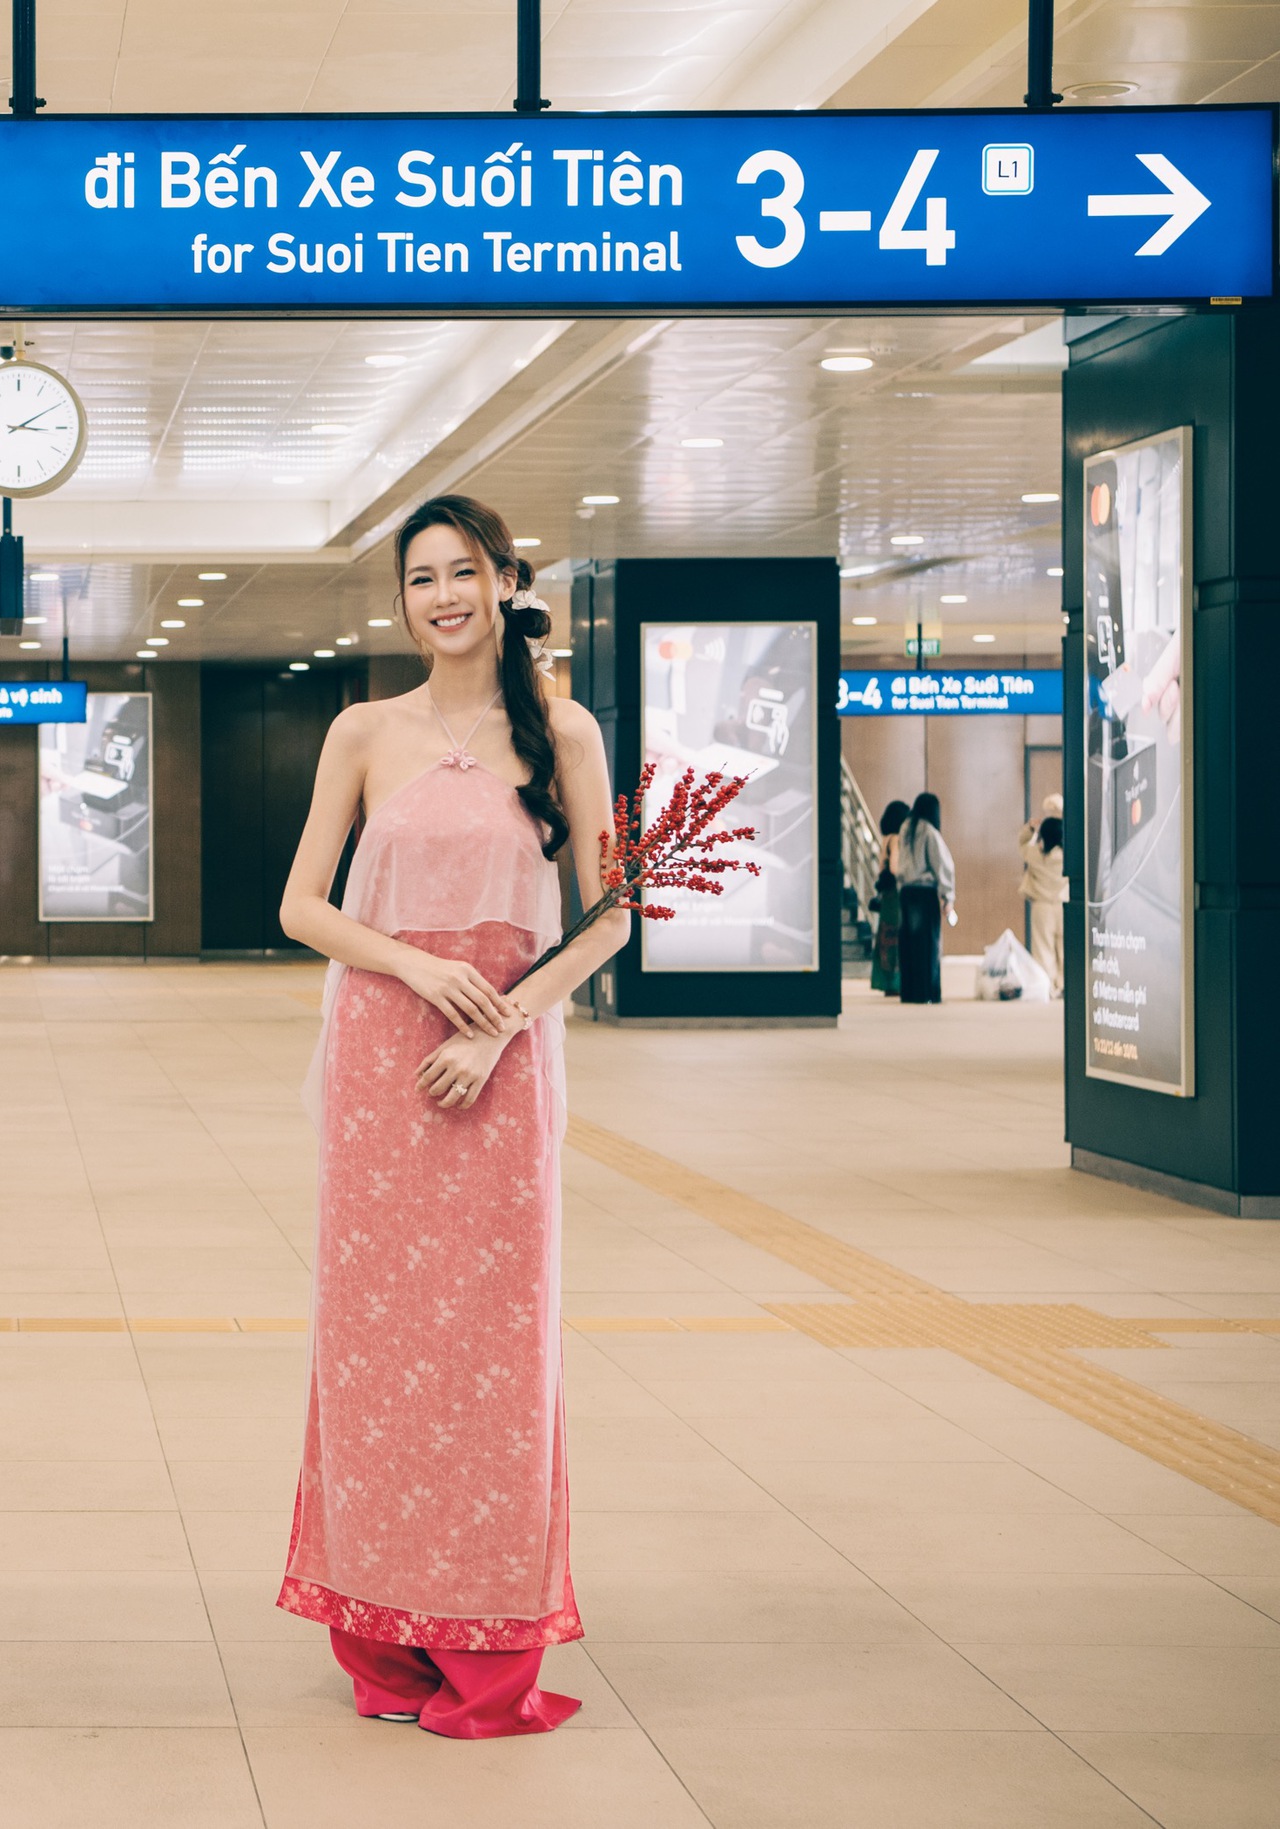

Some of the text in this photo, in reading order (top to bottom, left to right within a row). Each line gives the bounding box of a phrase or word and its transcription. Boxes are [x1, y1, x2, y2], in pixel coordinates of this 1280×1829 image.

[85, 143, 683, 209] đi Bến Xe Suối Tiên
[998, 160, 1018, 178] L1
[735, 149, 956, 268] 3-4
[192, 231, 682, 273] for Suoi Tien Terminal
[30, 687, 63, 704] sinh
[941, 677, 962, 694] Xe
